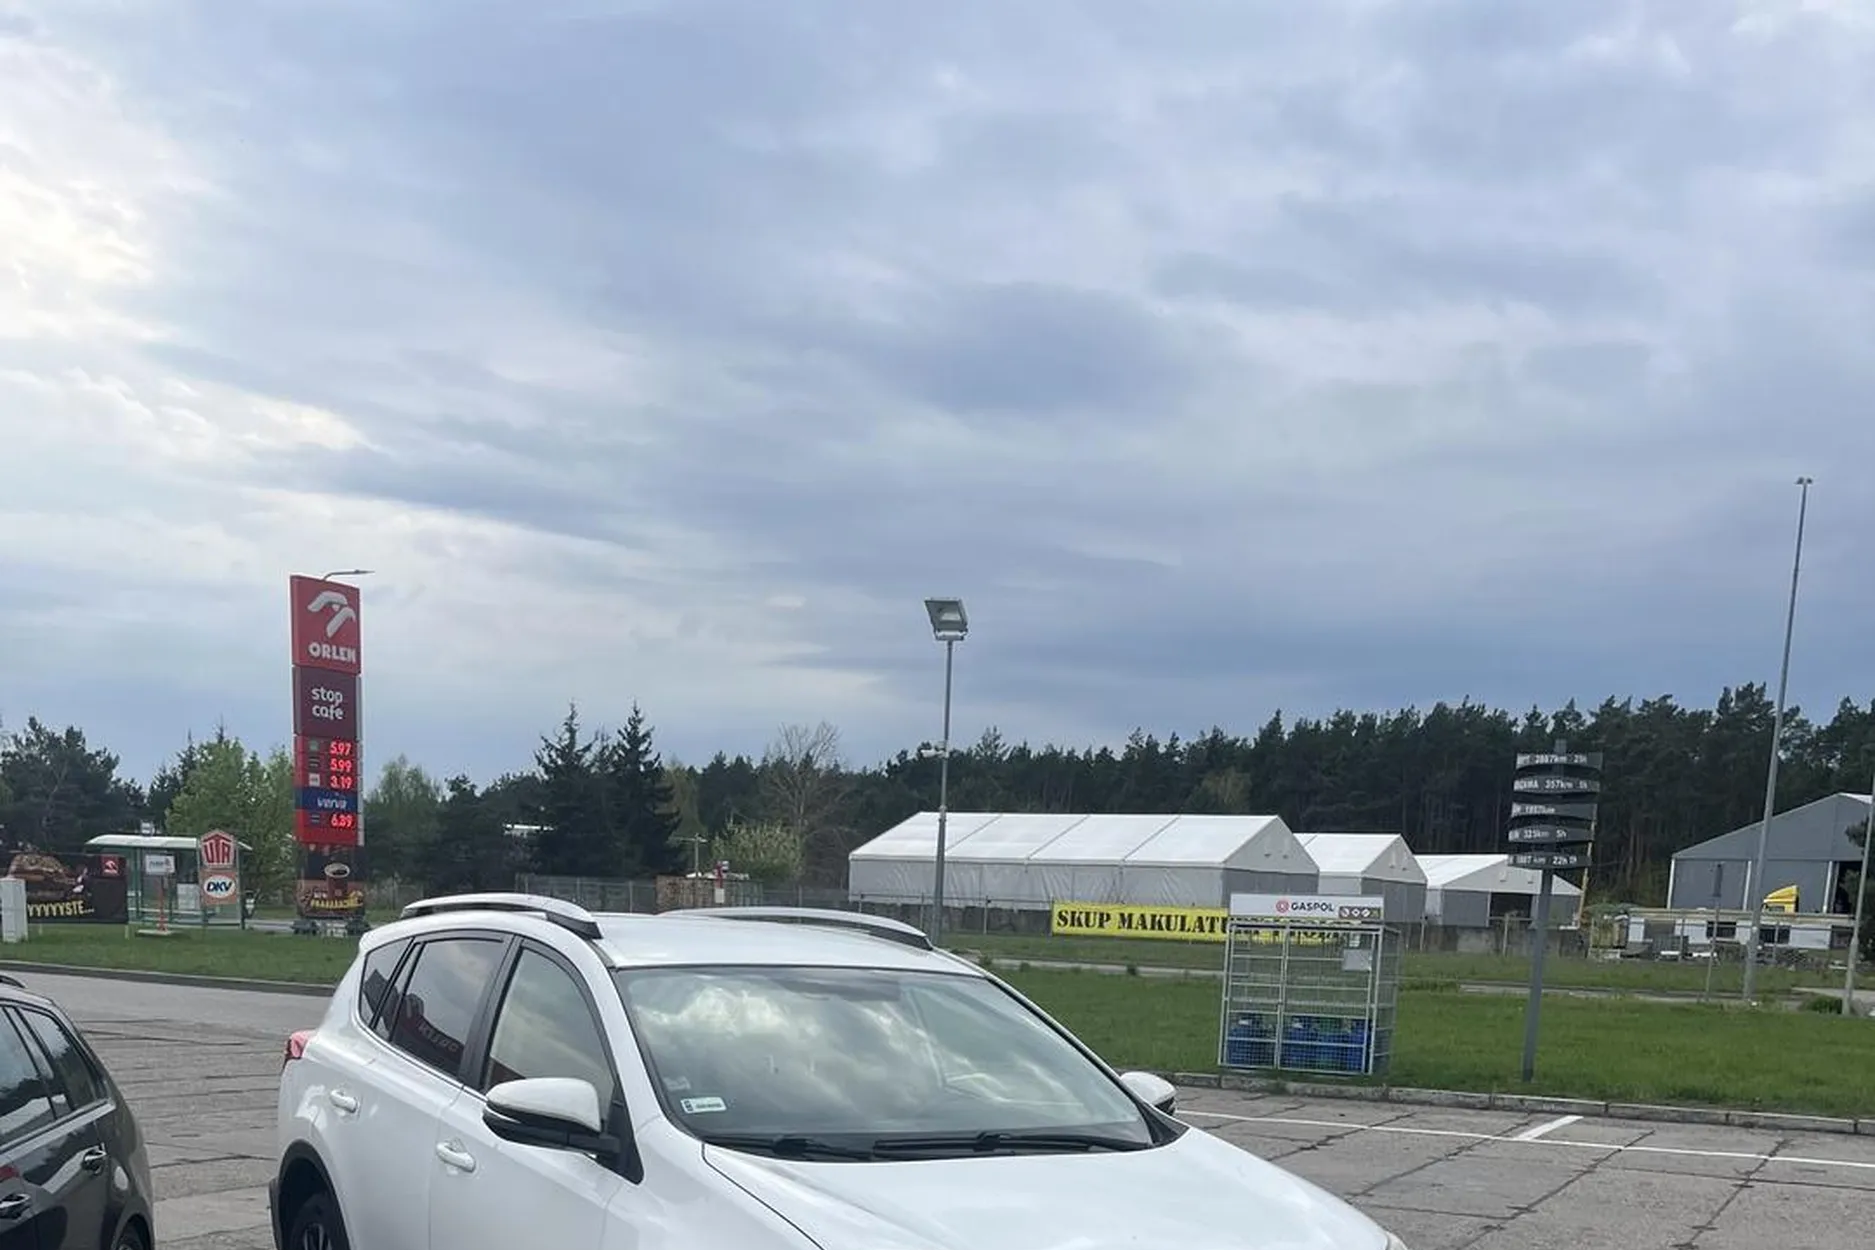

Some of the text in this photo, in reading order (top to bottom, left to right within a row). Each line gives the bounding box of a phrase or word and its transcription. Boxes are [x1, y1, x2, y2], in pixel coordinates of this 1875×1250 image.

[308, 642, 357, 664] ORLEN
[311, 687, 343, 706] stop
[312, 705, 344, 720] cafe
[330, 775, 352, 789] 3.19
[203, 833, 232, 864] UTA
[206, 881, 232, 892] DKV
[1290, 902, 1335, 912] GASPOL
[1056, 909, 1111, 929] SKUP
